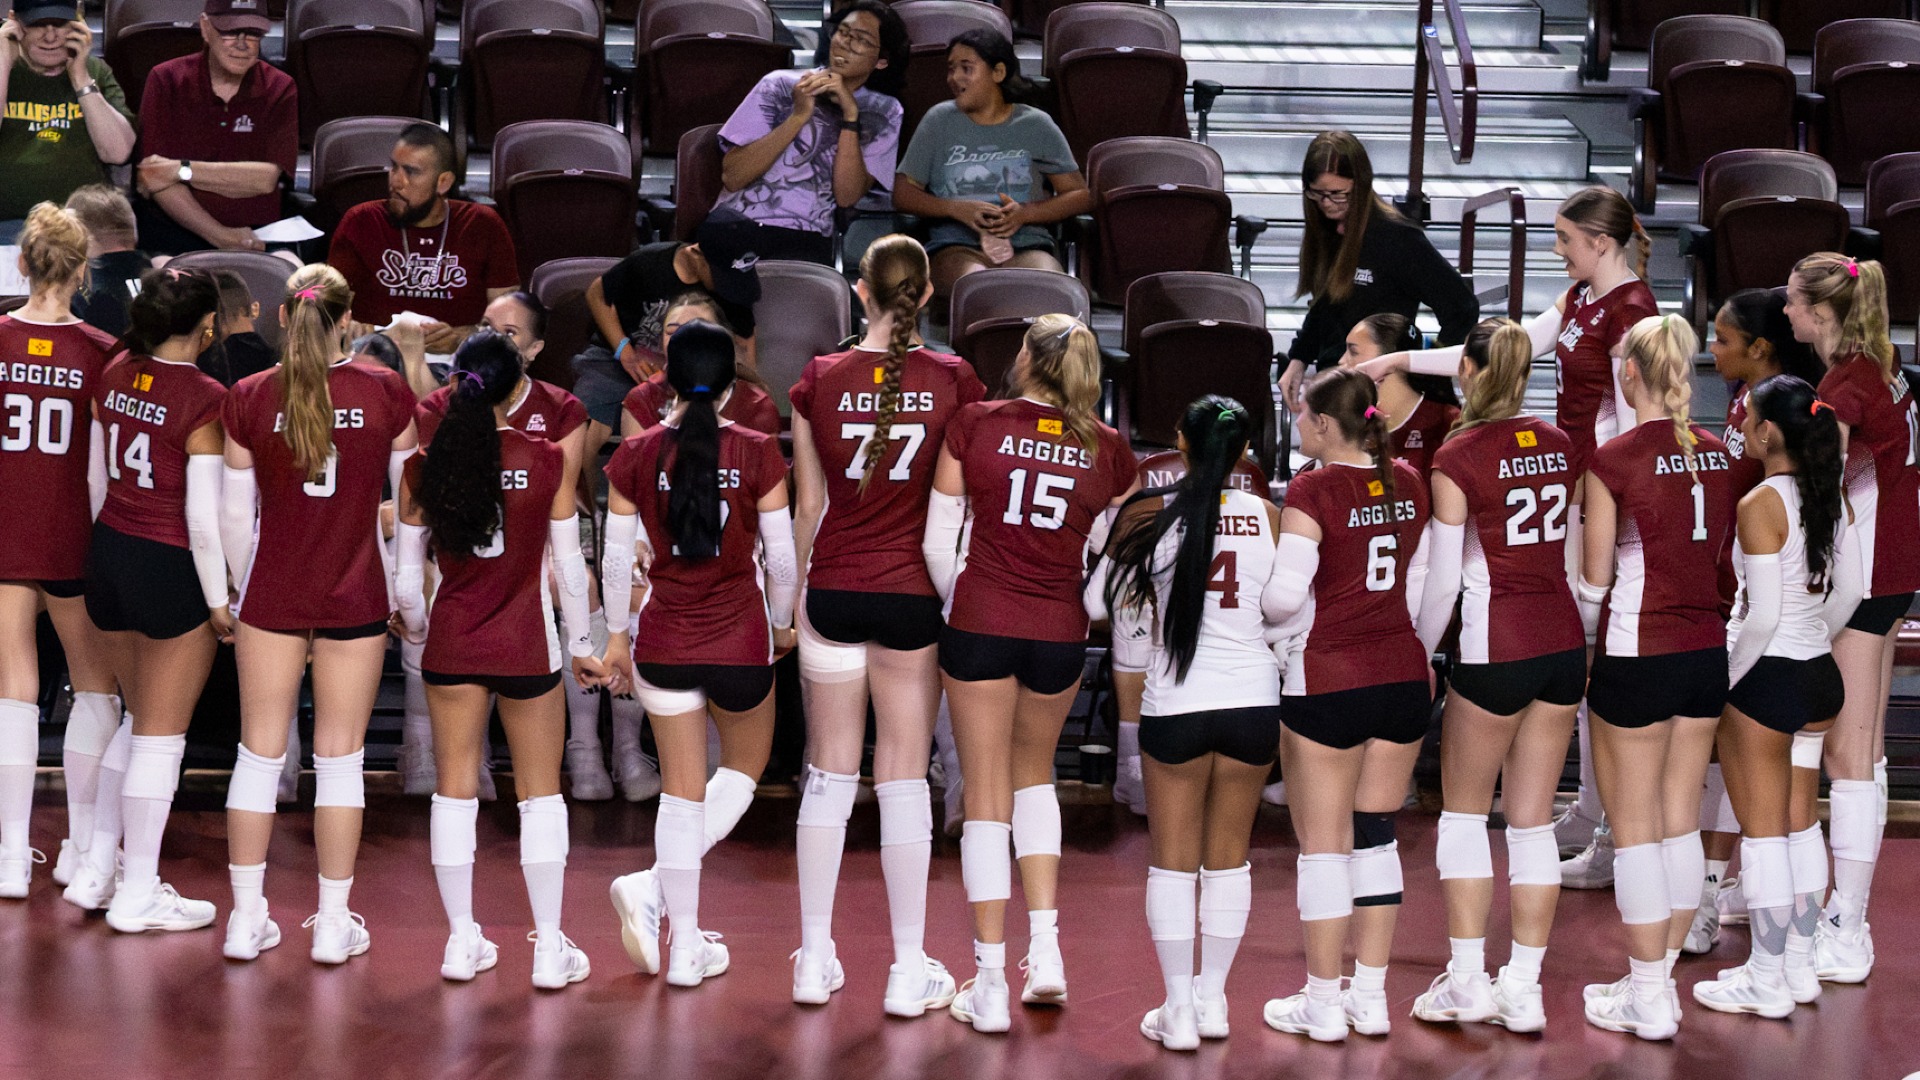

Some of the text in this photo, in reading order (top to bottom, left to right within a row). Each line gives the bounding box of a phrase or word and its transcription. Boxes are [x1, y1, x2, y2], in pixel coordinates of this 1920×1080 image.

[3, 102, 66, 122] ARKANSAS
[389, 288, 453, 299] BASEBALL
[0, 362, 84, 390] AGGIES
[1, 393, 74, 455] 30
[104, 390, 167, 426] AGGIES
[108, 422, 154, 489] 14
[841, 423, 926, 481] 77
[997, 435, 1092, 470] AGGIES
[1498, 452, 1568, 479] AGGIES
[1655, 451, 1729, 475] AGGIES
[658, 468, 740, 491] AES
[1002, 468, 1076, 530] 15
[1347, 500, 1416, 528] AGGIES
[1506, 484, 1567, 546] 22
[1690, 483, 1708, 541] 1
[1205, 550, 1240, 609] 4
[1365, 534, 1397, 592] 6
